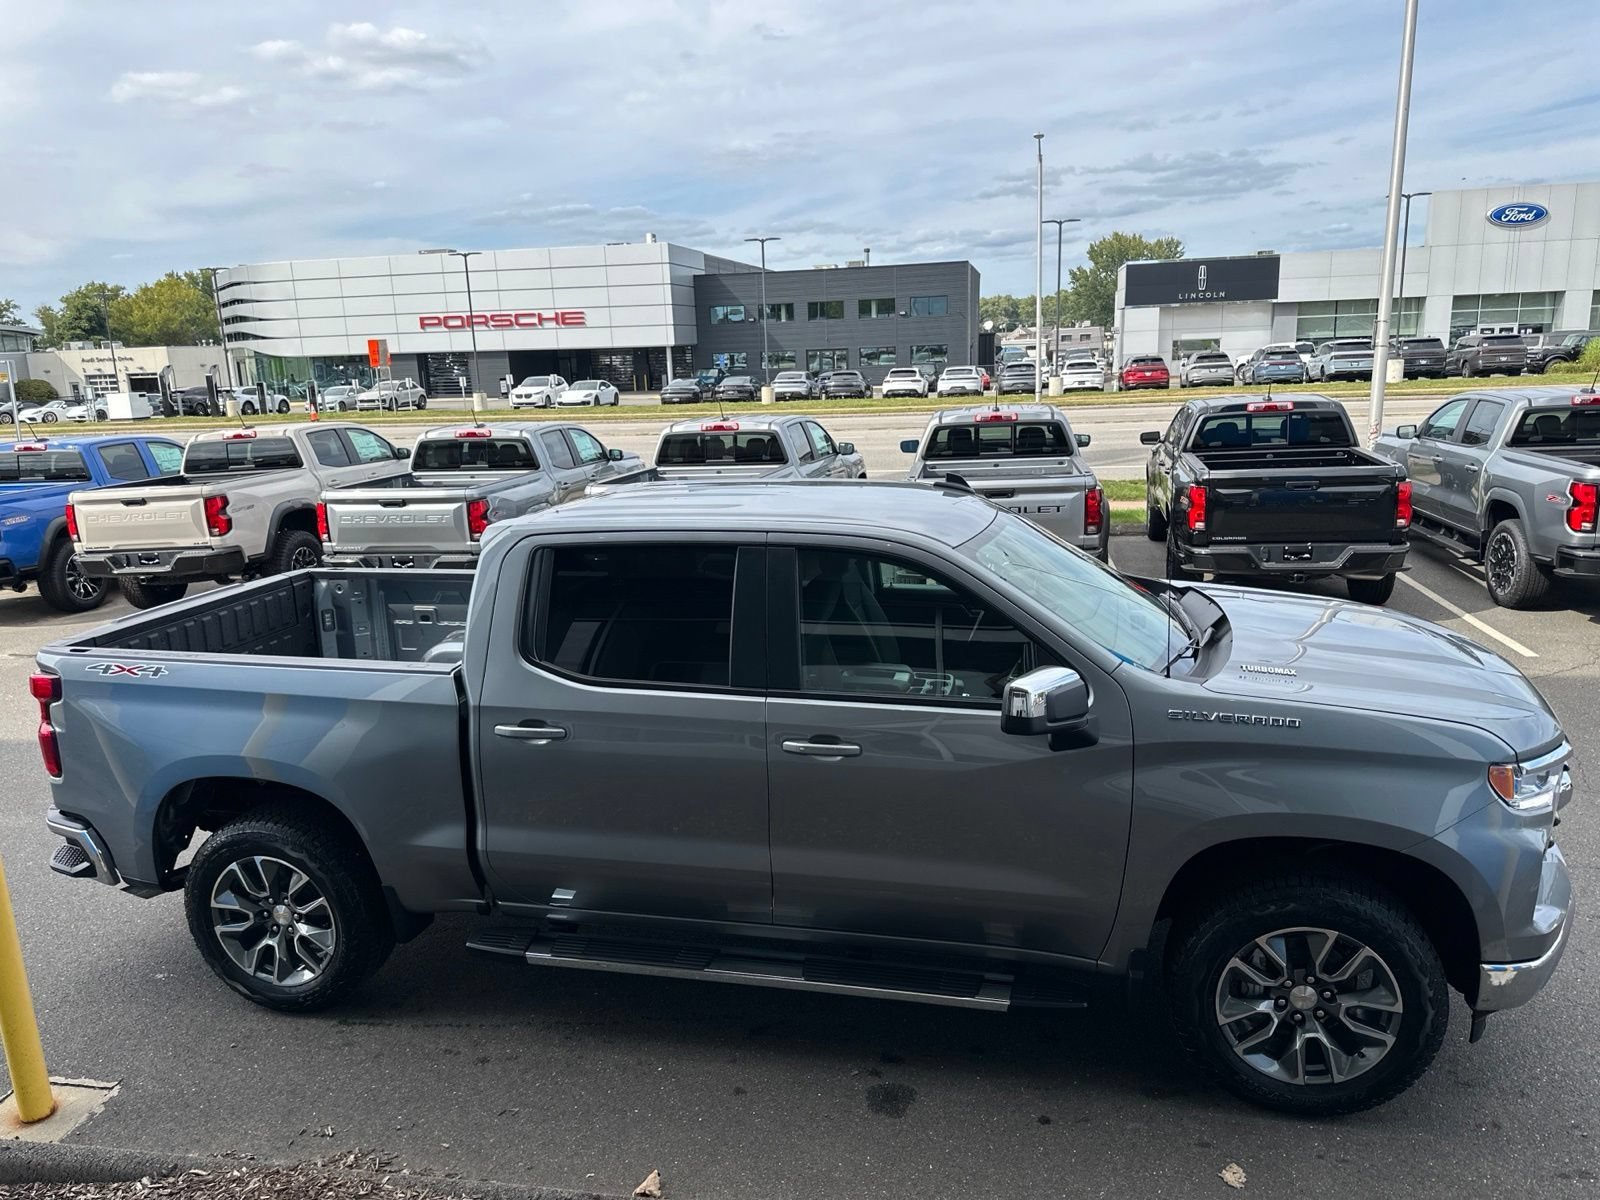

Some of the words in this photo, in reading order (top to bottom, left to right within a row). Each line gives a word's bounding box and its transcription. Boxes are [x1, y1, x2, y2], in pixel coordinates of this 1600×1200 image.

[1501, 207, 1537, 222] Ford
[1178, 291, 1226, 300] LINCOLN
[419, 311, 588, 331] PORSCHE
[87, 511, 188, 524] CHEVROLET
[339, 513, 451, 524] CHEVROLET
[1240, 664, 1297, 677] TURBOMAX
[1167, 709, 1302, 728] SILVERADO
